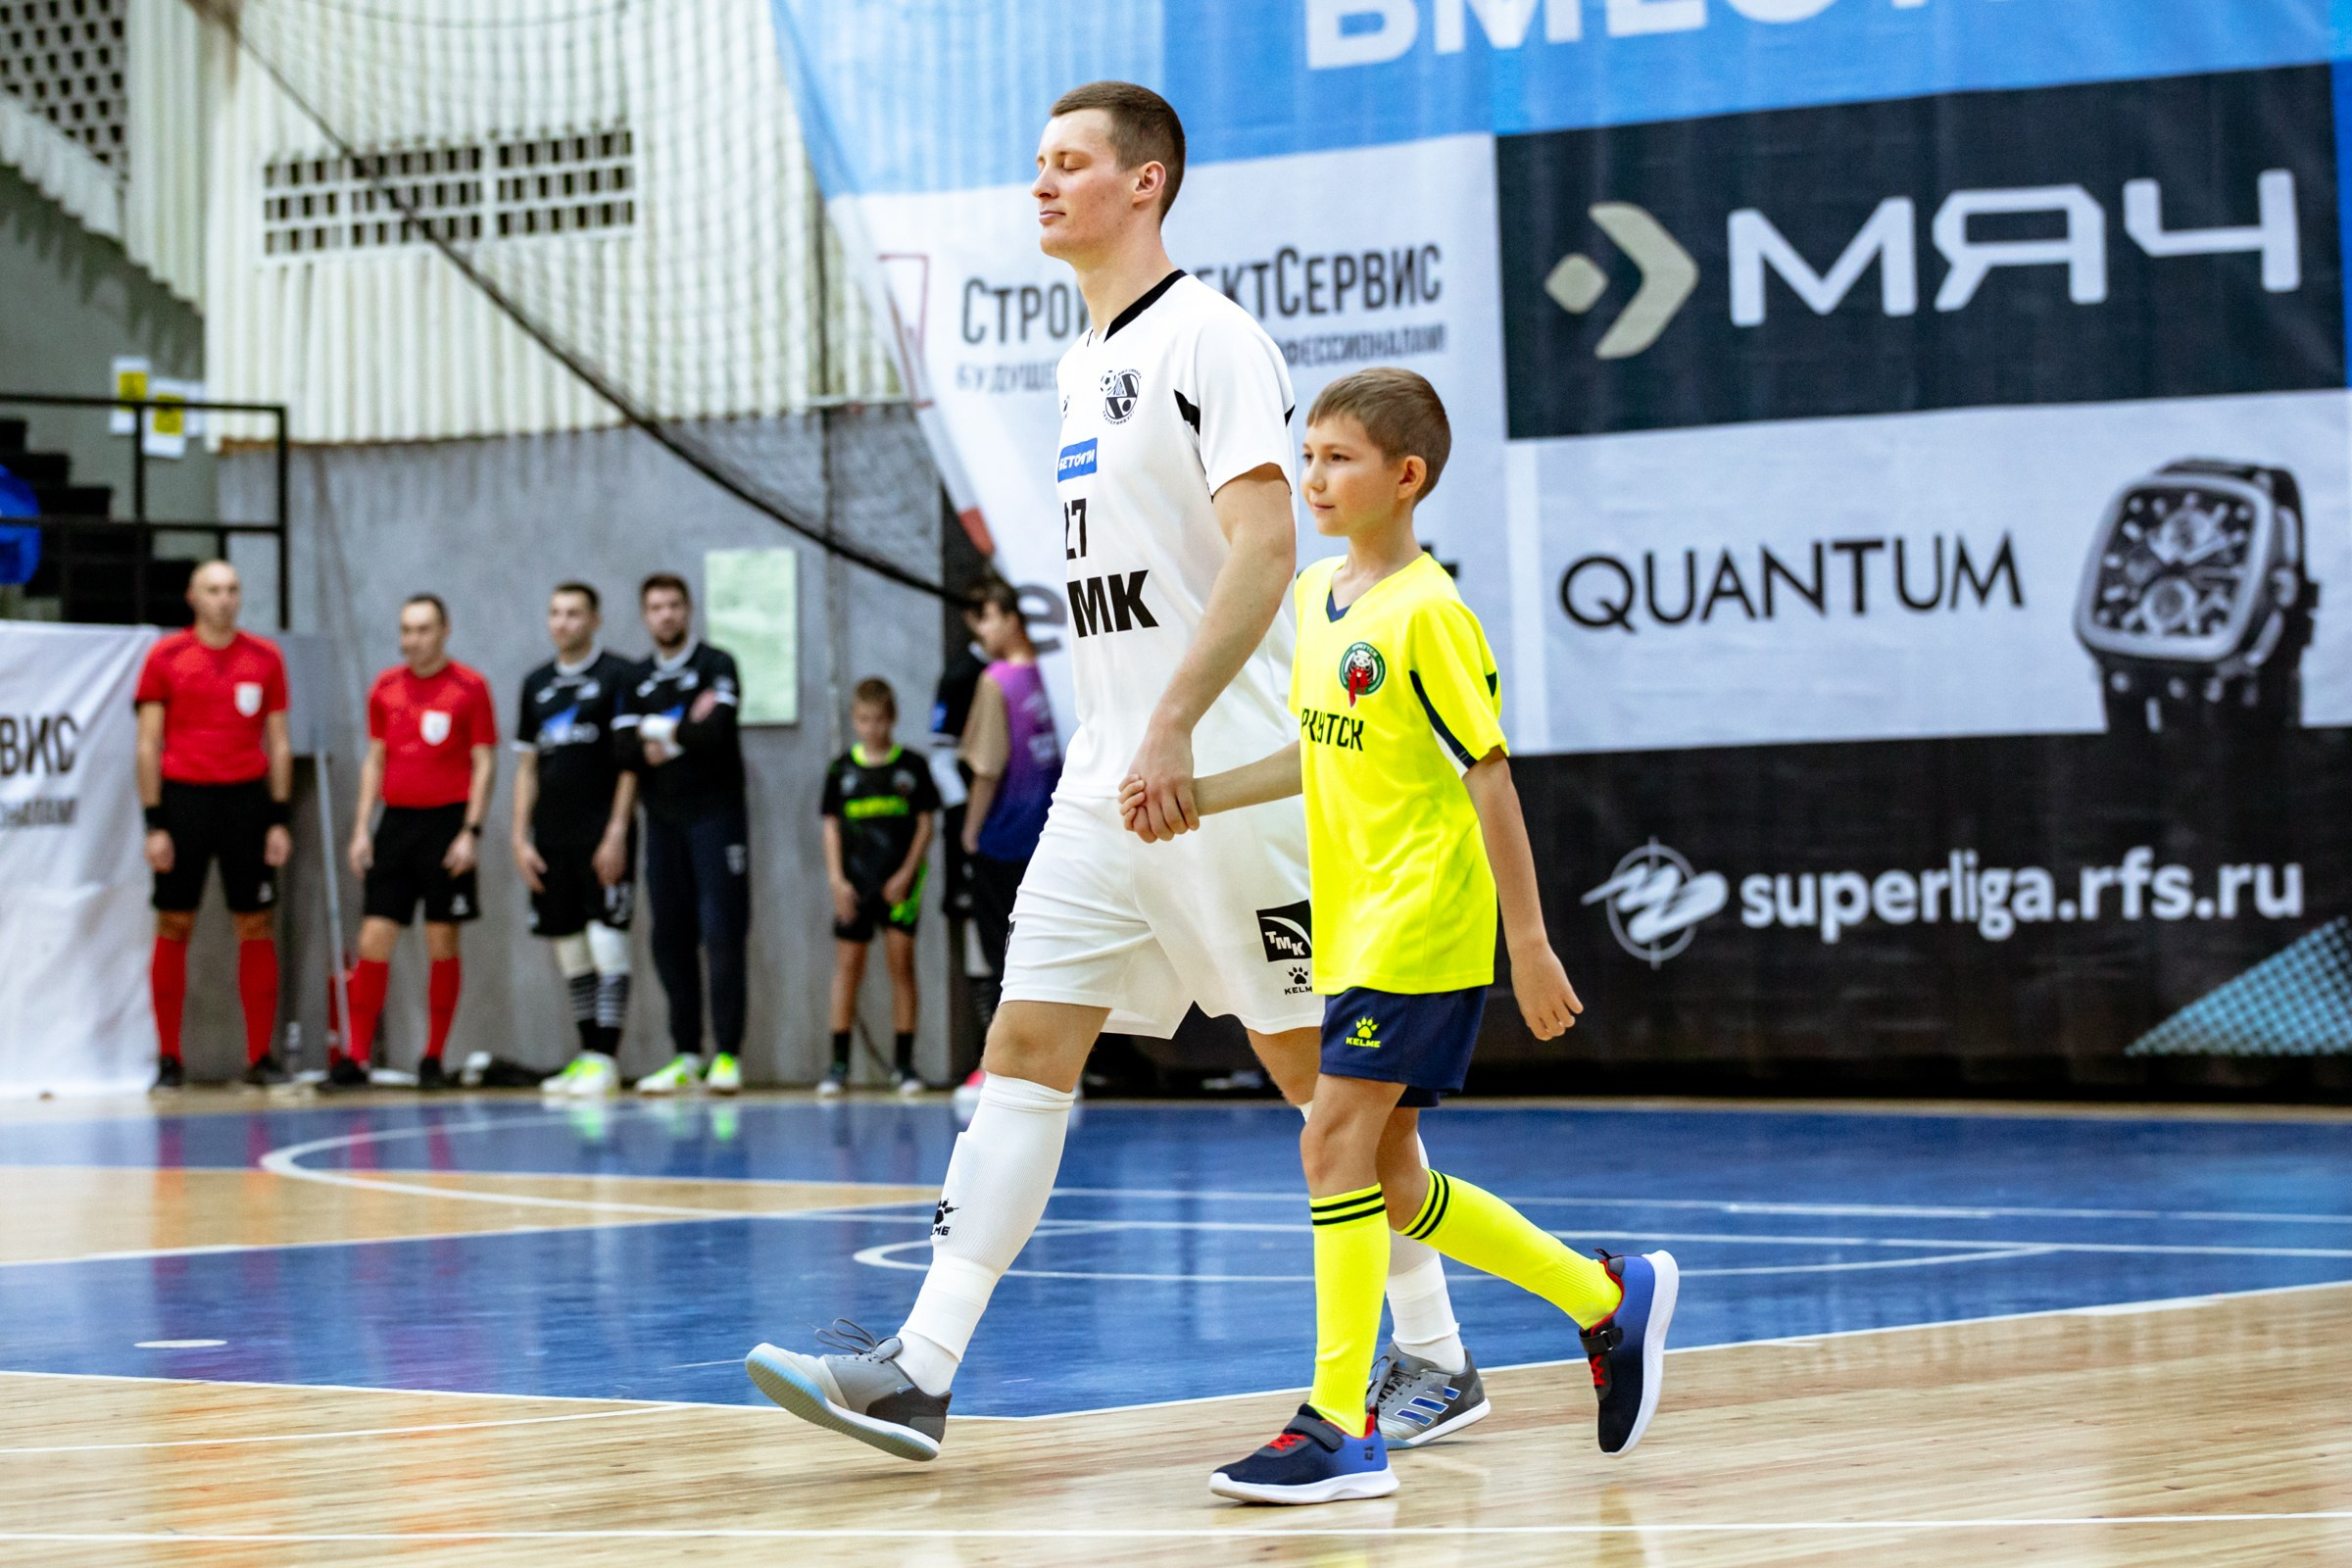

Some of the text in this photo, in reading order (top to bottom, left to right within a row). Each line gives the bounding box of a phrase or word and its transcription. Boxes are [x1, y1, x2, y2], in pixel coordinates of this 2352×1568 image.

[1728, 169, 2301, 327] МЯЧ
[1067, 569, 1159, 638] МК
[1559, 529, 2025, 634] QUANTUM
[1740, 847, 2304, 944] superliga.rfs.ru
[1284, 986, 1313, 995] KELM
[1346, 1037, 1382, 1049] KELME
